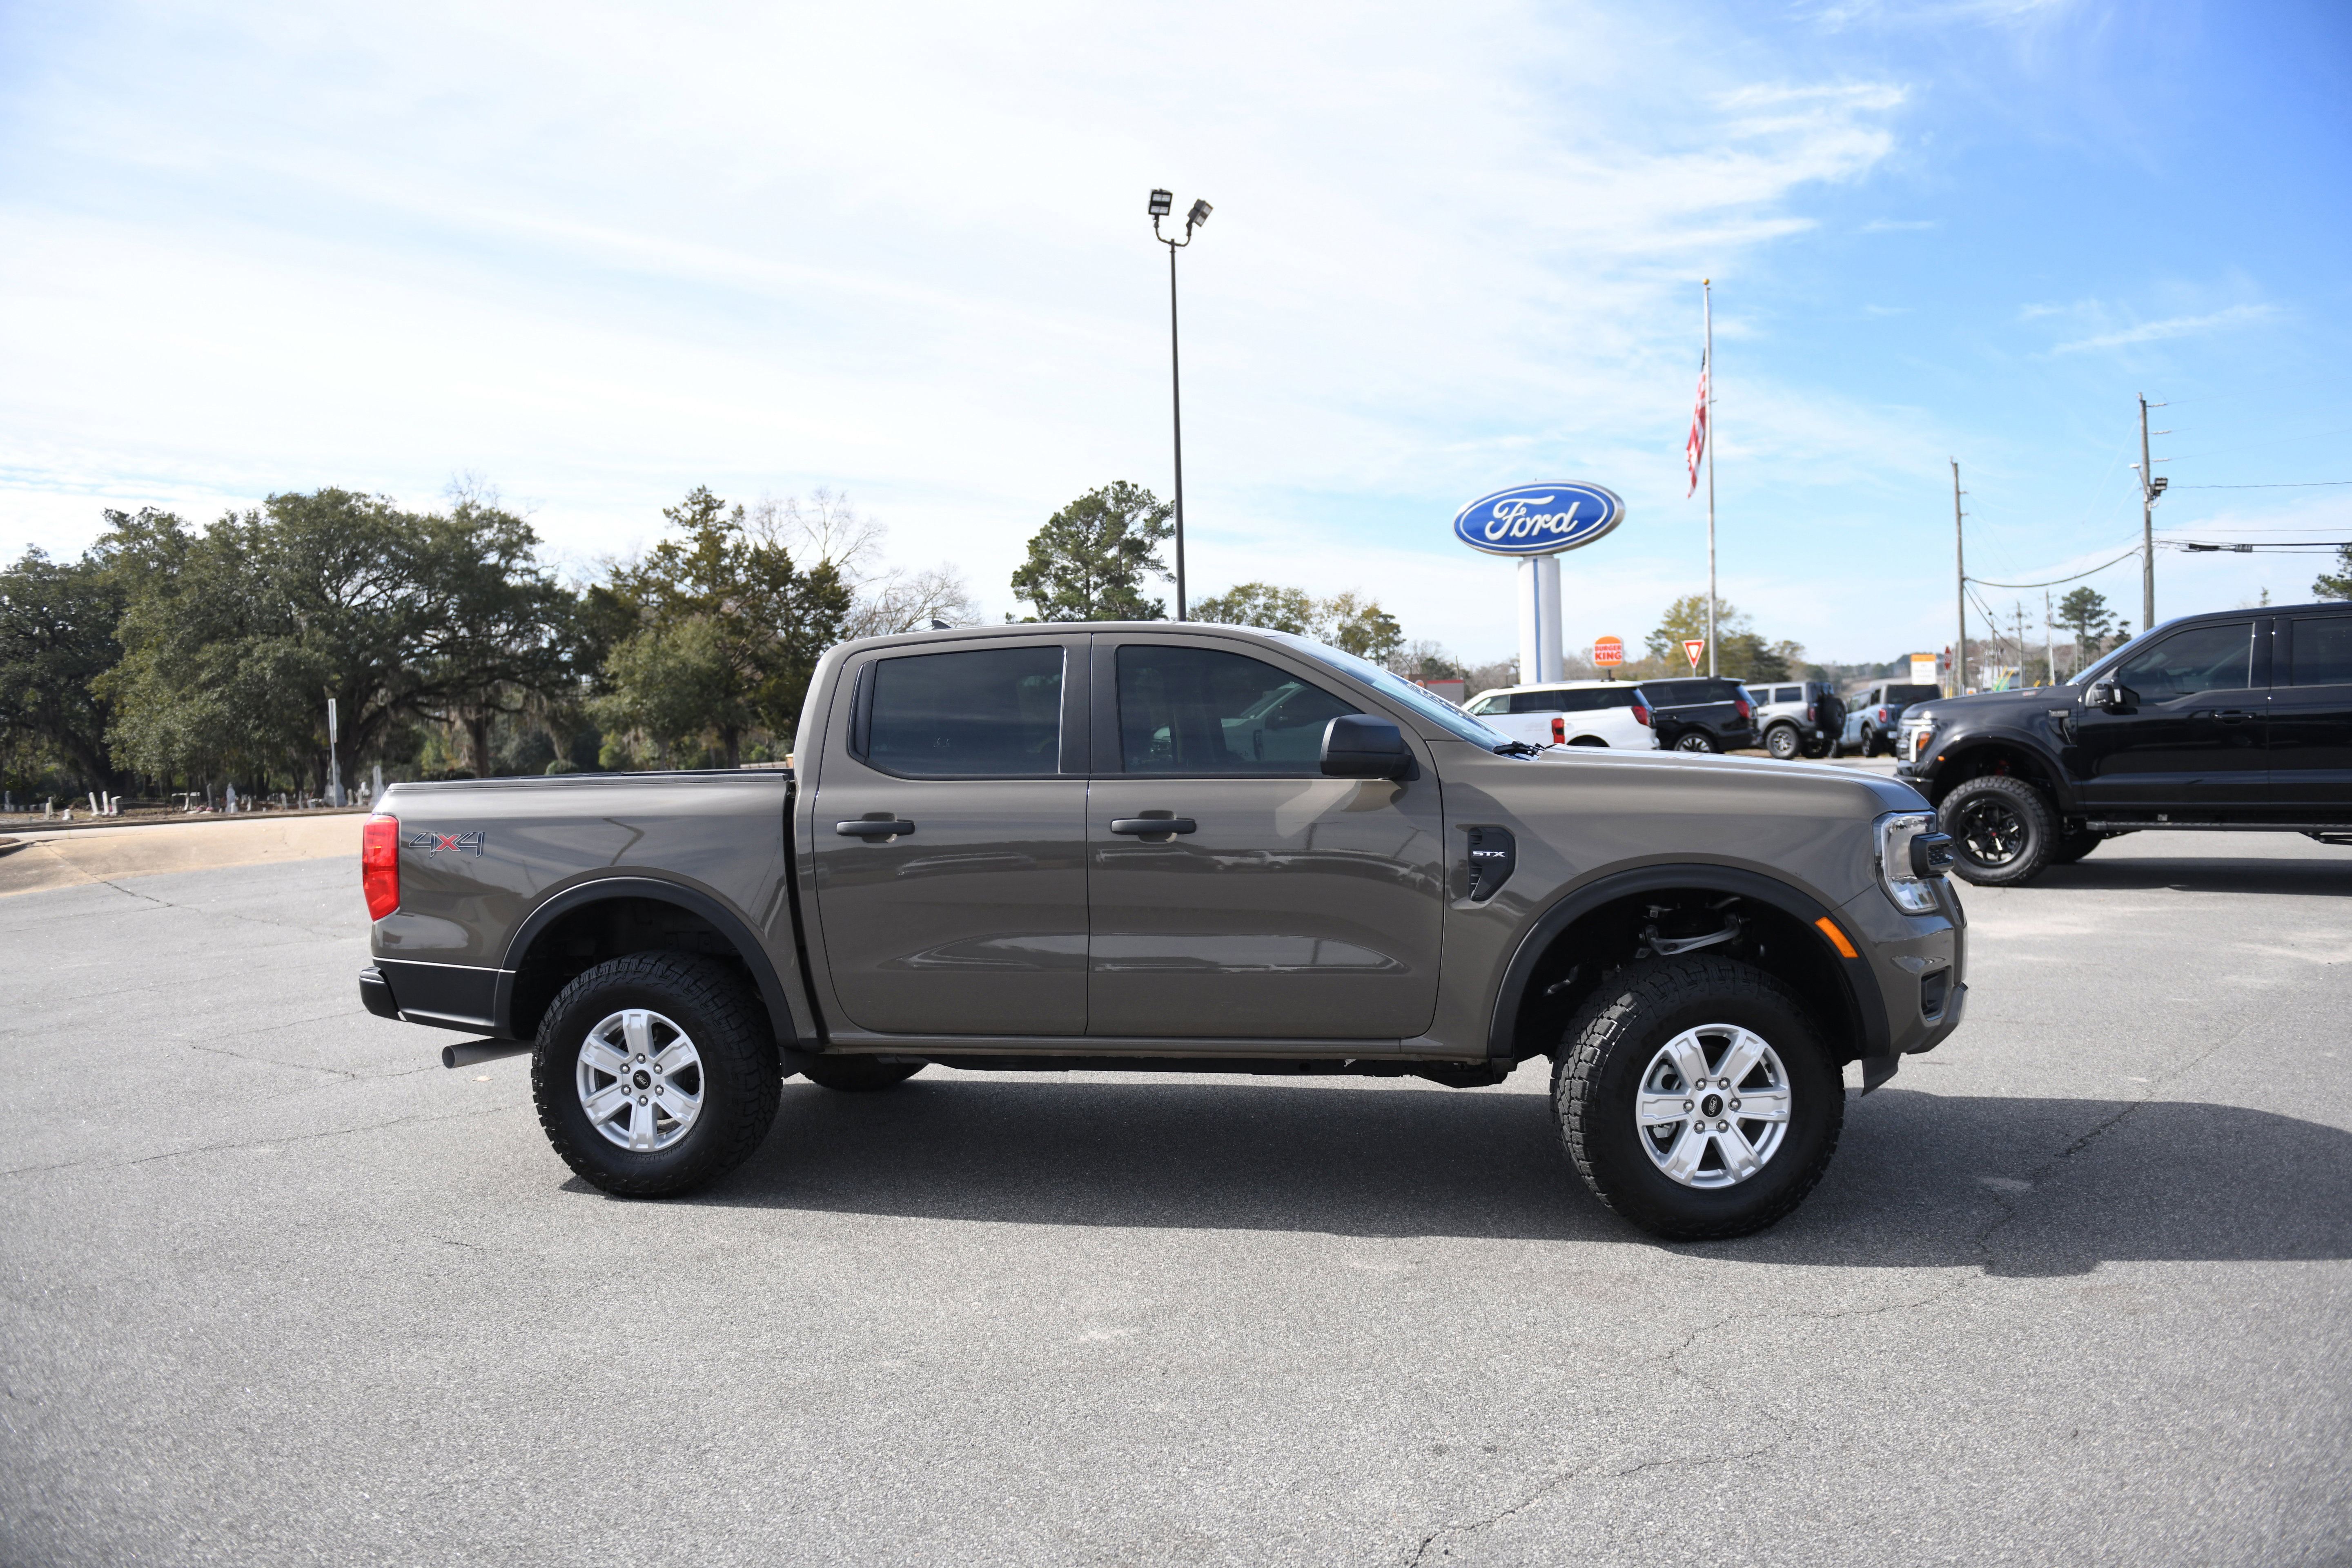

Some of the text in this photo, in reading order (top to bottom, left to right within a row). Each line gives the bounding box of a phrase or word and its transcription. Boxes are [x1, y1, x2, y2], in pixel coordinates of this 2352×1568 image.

[1485, 495, 1580, 541] Ford
[1595, 652, 1622, 660] KING
[637, 1076, 646, 1085] Ford
